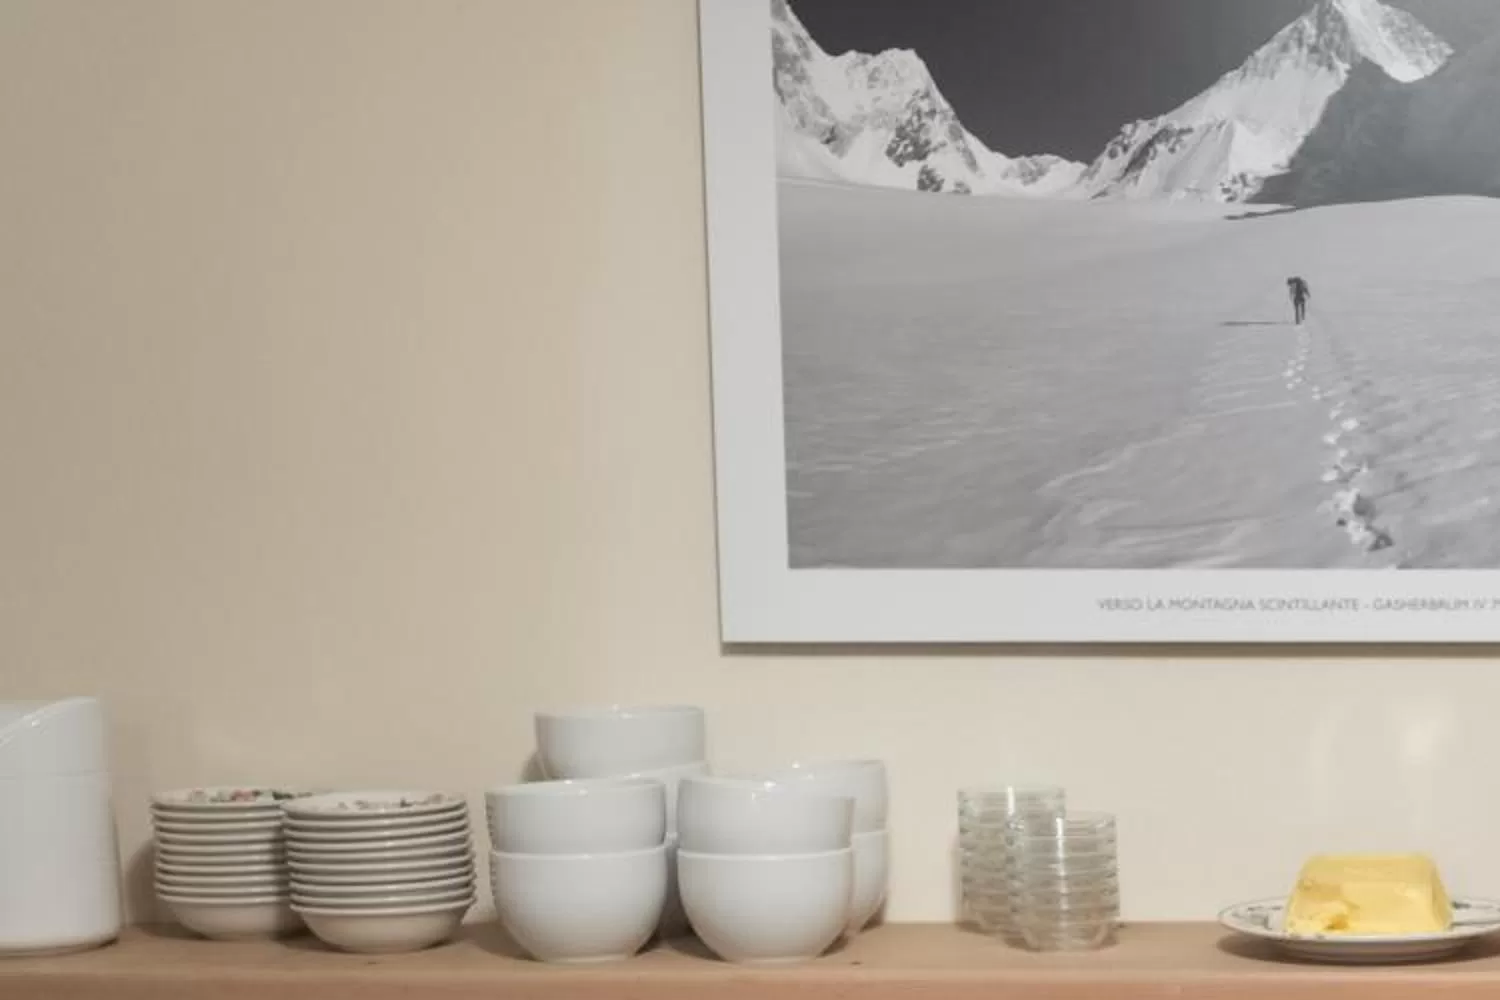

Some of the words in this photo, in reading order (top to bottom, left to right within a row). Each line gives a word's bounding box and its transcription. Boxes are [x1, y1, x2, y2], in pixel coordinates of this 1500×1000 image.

[1096, 597, 1143, 611] VERSO
[1146, 597, 1165, 611] LA
[1168, 597, 1256, 611] MONTAGNA
[1259, 597, 1360, 611] SCINTILLANTE
